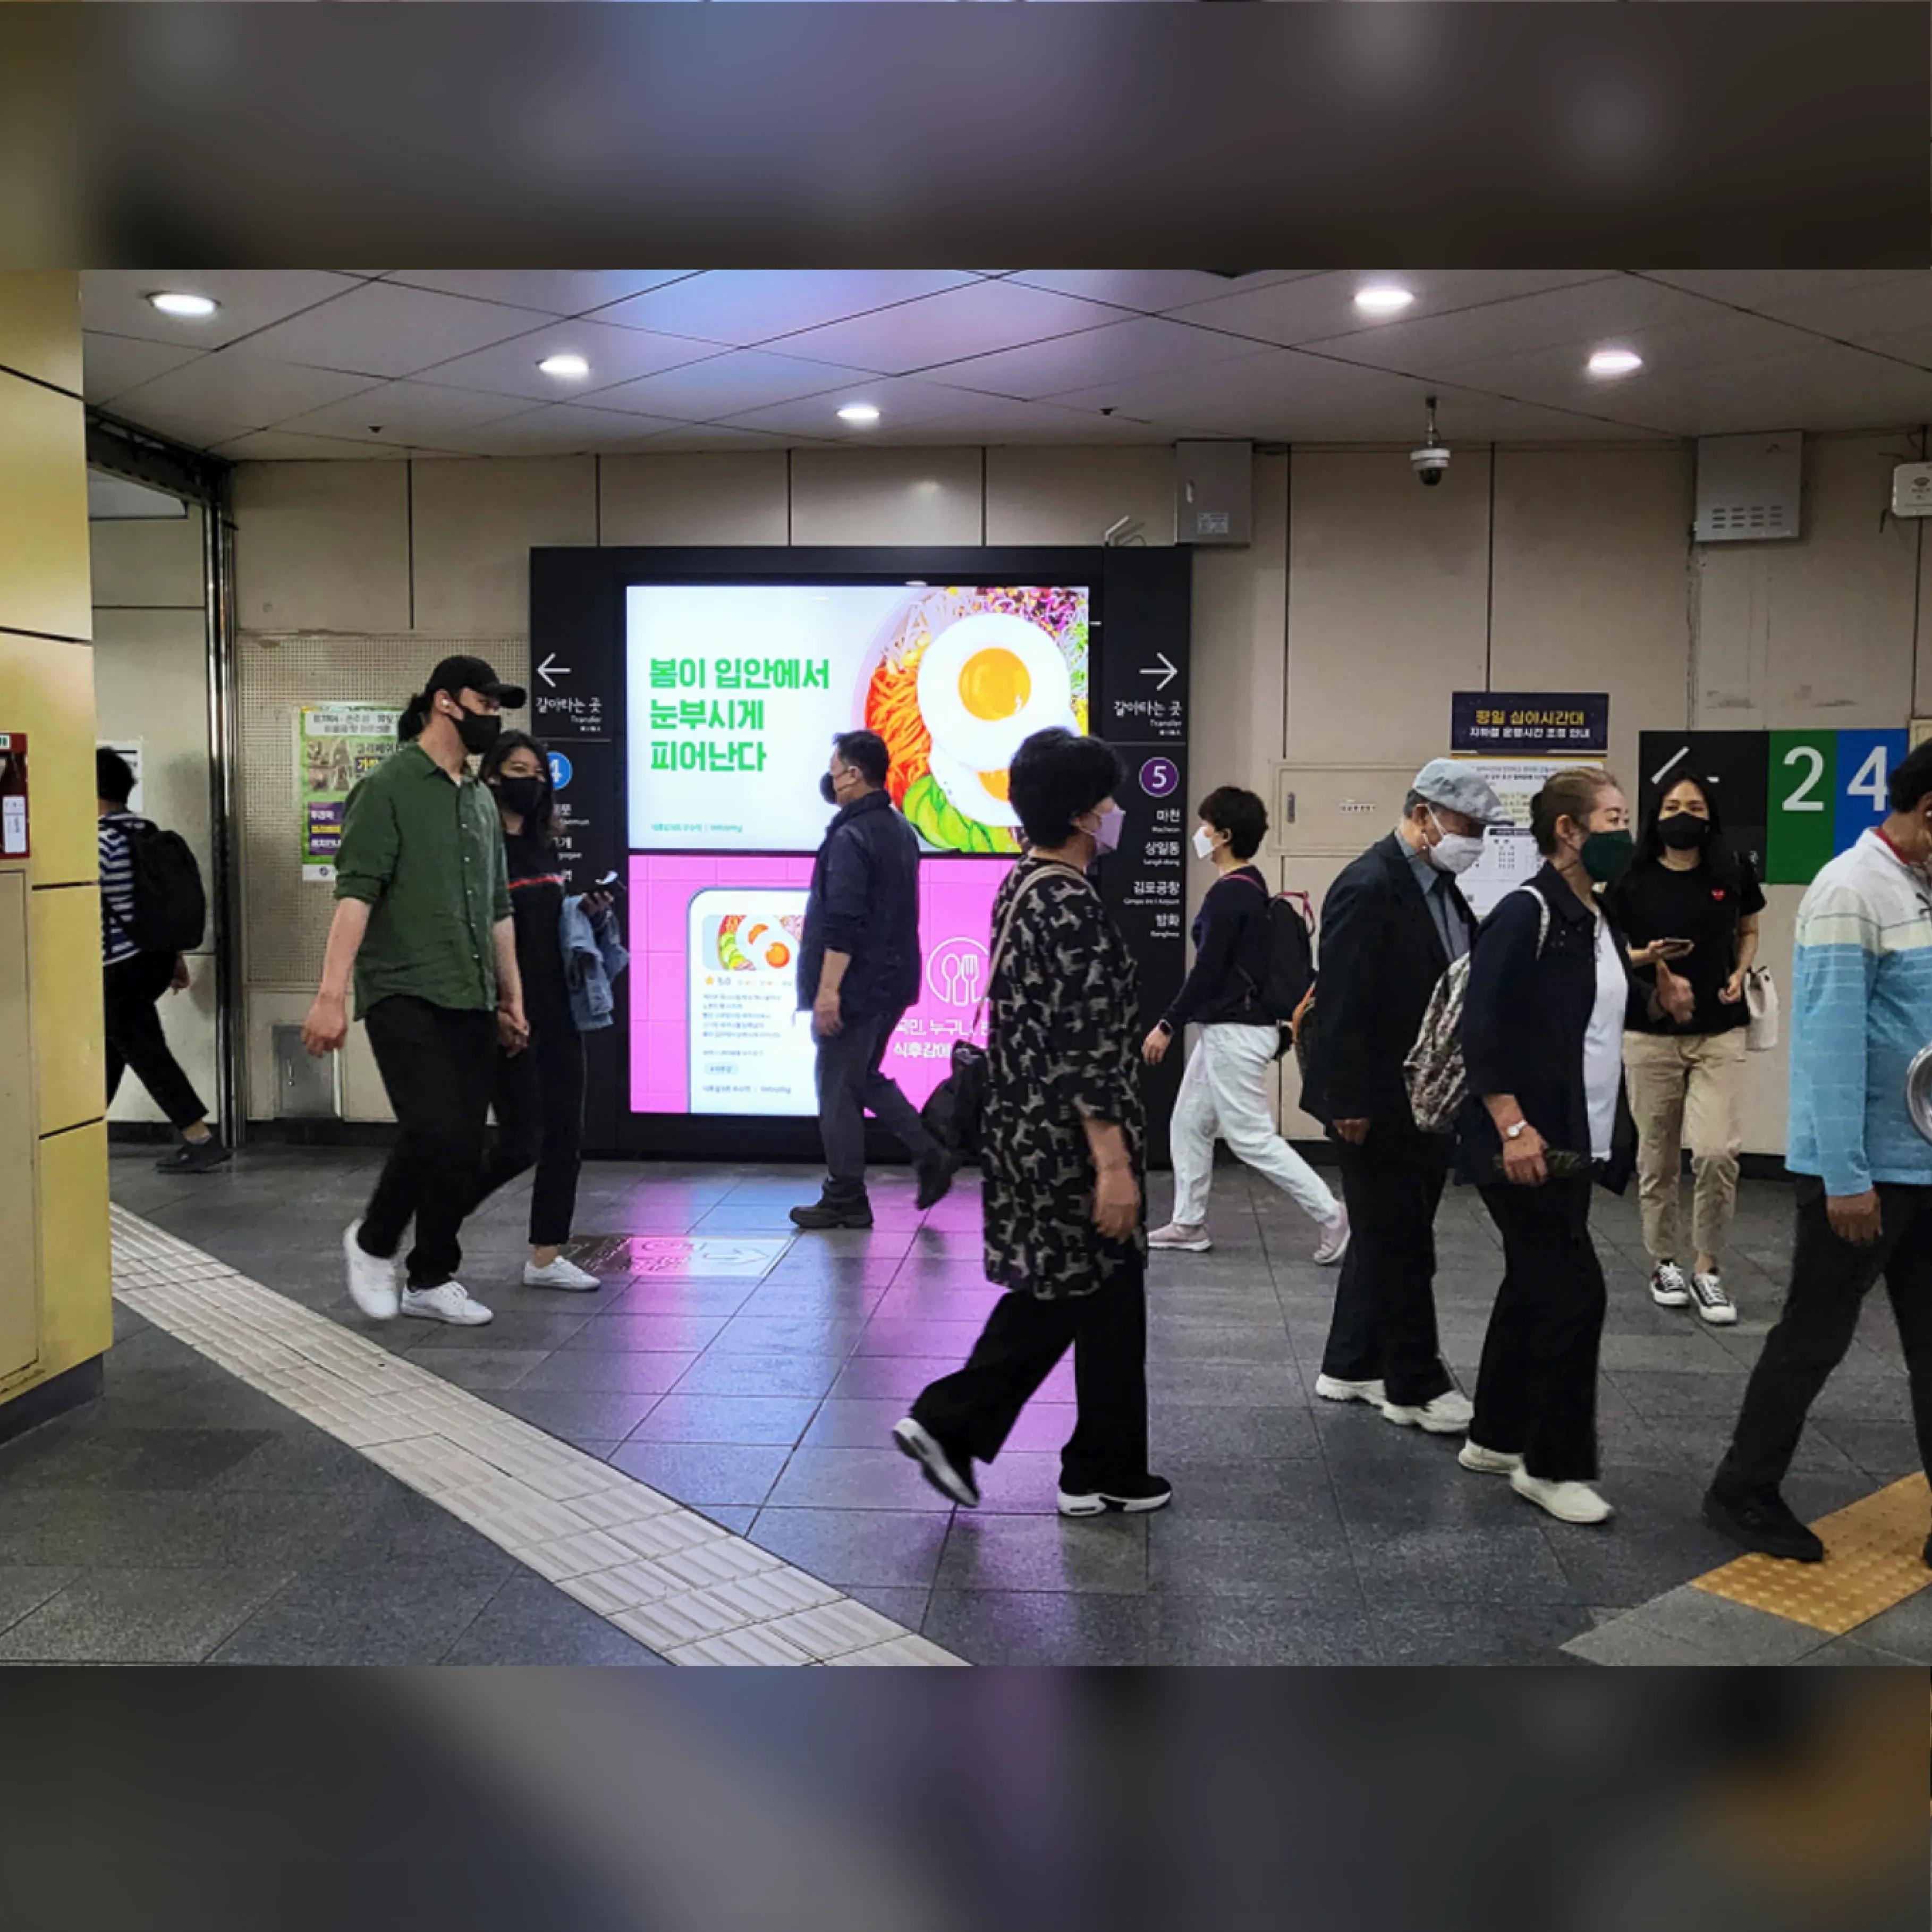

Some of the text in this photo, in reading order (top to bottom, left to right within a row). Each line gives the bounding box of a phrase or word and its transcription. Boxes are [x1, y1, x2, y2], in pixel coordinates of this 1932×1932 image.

[650, 658, 829, 689] 봄이 입안에서
[536, 697, 603, 714] 갈아타는 곳
[650, 699, 765, 730] 눈부시게
[1114, 700, 1182, 717] 갈아타는 곳
[650, 741, 767, 772] 피어난다
[1152, 765, 1167, 789] 5
[1782, 745, 1890, 812] 2 4
